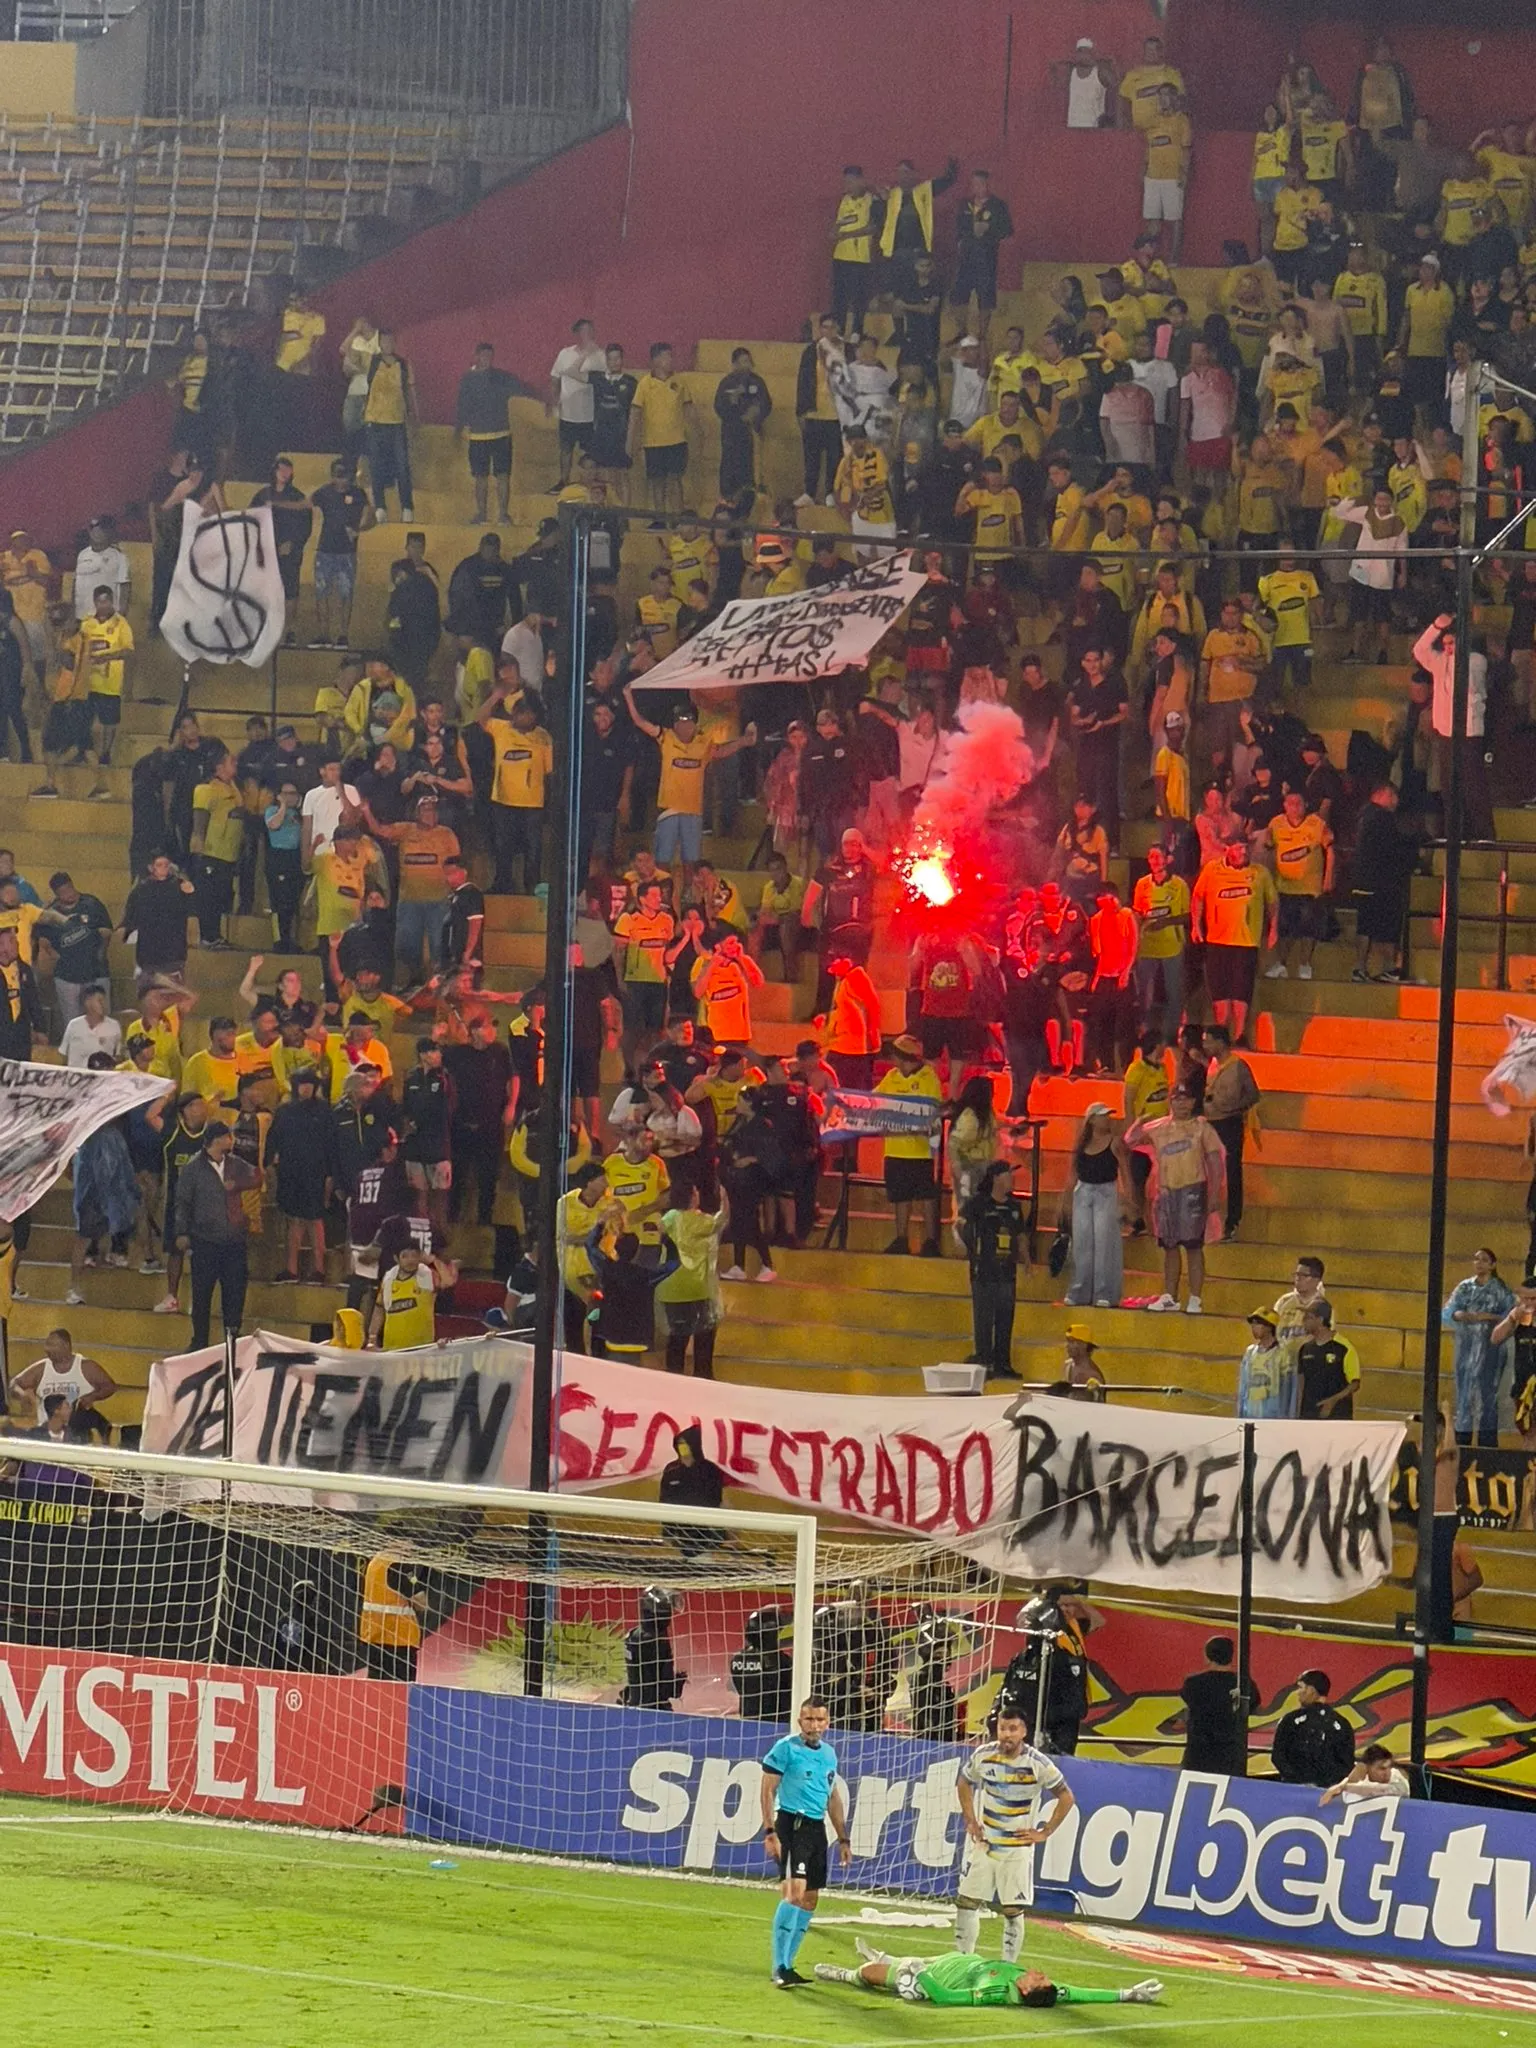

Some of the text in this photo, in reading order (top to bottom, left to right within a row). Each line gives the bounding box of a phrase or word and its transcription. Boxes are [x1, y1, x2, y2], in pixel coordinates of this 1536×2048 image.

[165, 1360, 243, 1457] TE
[256, 1351, 512, 1484] TIENEN
[0, 1658, 307, 1807] MSTEL
[731, 1660, 763, 1672] POLICIA
